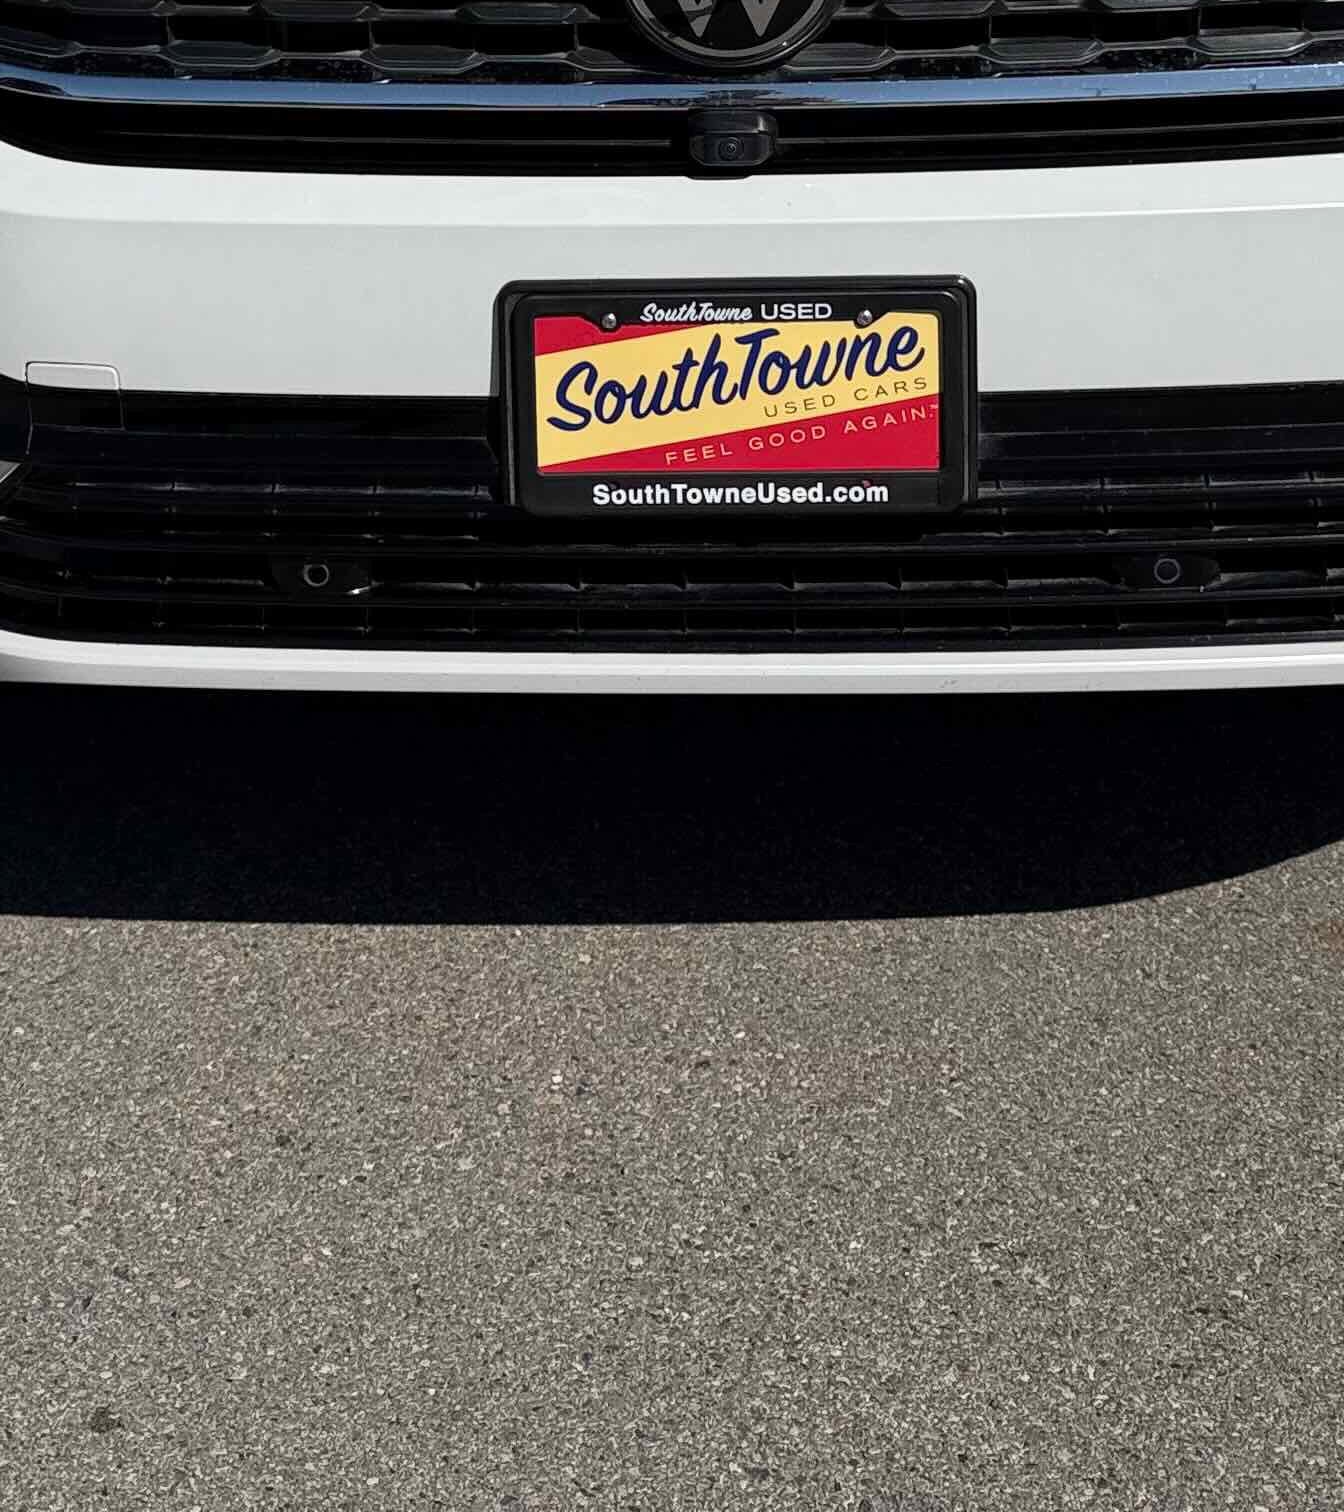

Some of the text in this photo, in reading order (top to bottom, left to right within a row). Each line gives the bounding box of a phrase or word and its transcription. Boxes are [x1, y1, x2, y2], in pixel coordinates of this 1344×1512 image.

[640, 302, 833, 322] SouthTowne USED
[546, 326, 925, 432] SouthTowne
[763, 376, 928, 419] USED CARS
[665, 442, 734, 466] FEEL
[748, 425, 827, 451] GOOD
[592, 482, 889, 506] SouthTowneUsed.com
